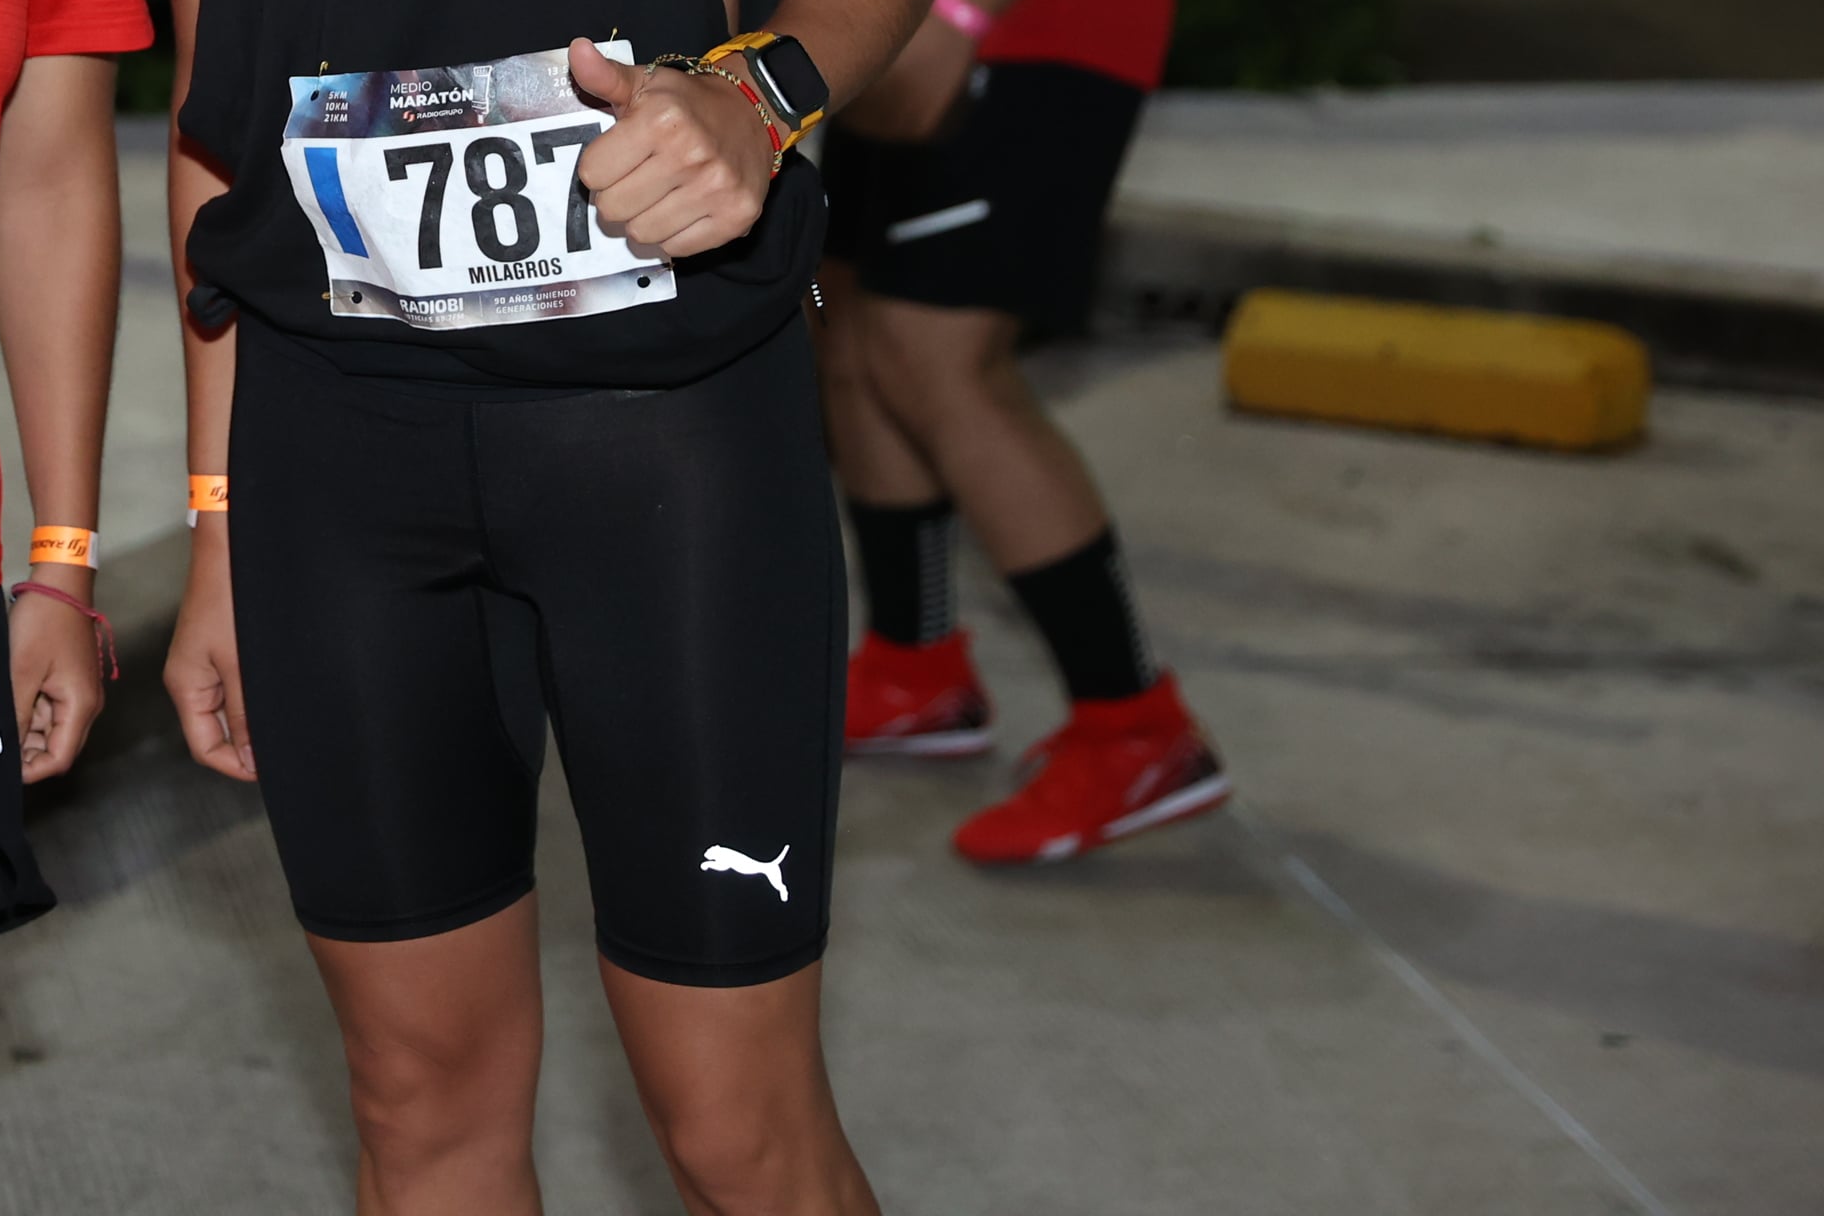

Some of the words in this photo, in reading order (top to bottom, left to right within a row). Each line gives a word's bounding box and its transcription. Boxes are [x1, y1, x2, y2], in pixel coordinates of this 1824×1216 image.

[390, 81, 432, 94] MEDIO
[328, 91, 348, 100] 5KM
[389, 87, 474, 110] MARATÓN
[325, 101, 349, 111] 10KM
[323, 113, 348, 122] 21KM
[416, 108, 464, 120] RADIOGRUPO
[383, 122, 603, 271] 787
[468, 257, 563, 284] MILAGROS
[494, 297, 506, 305] 90
[509, 294, 534, 304] AÑOS
[536, 288, 577, 301] UNIENDO
[399, 297, 464, 315] RADIOBI
[496, 300, 564, 314] GENERACIONES
